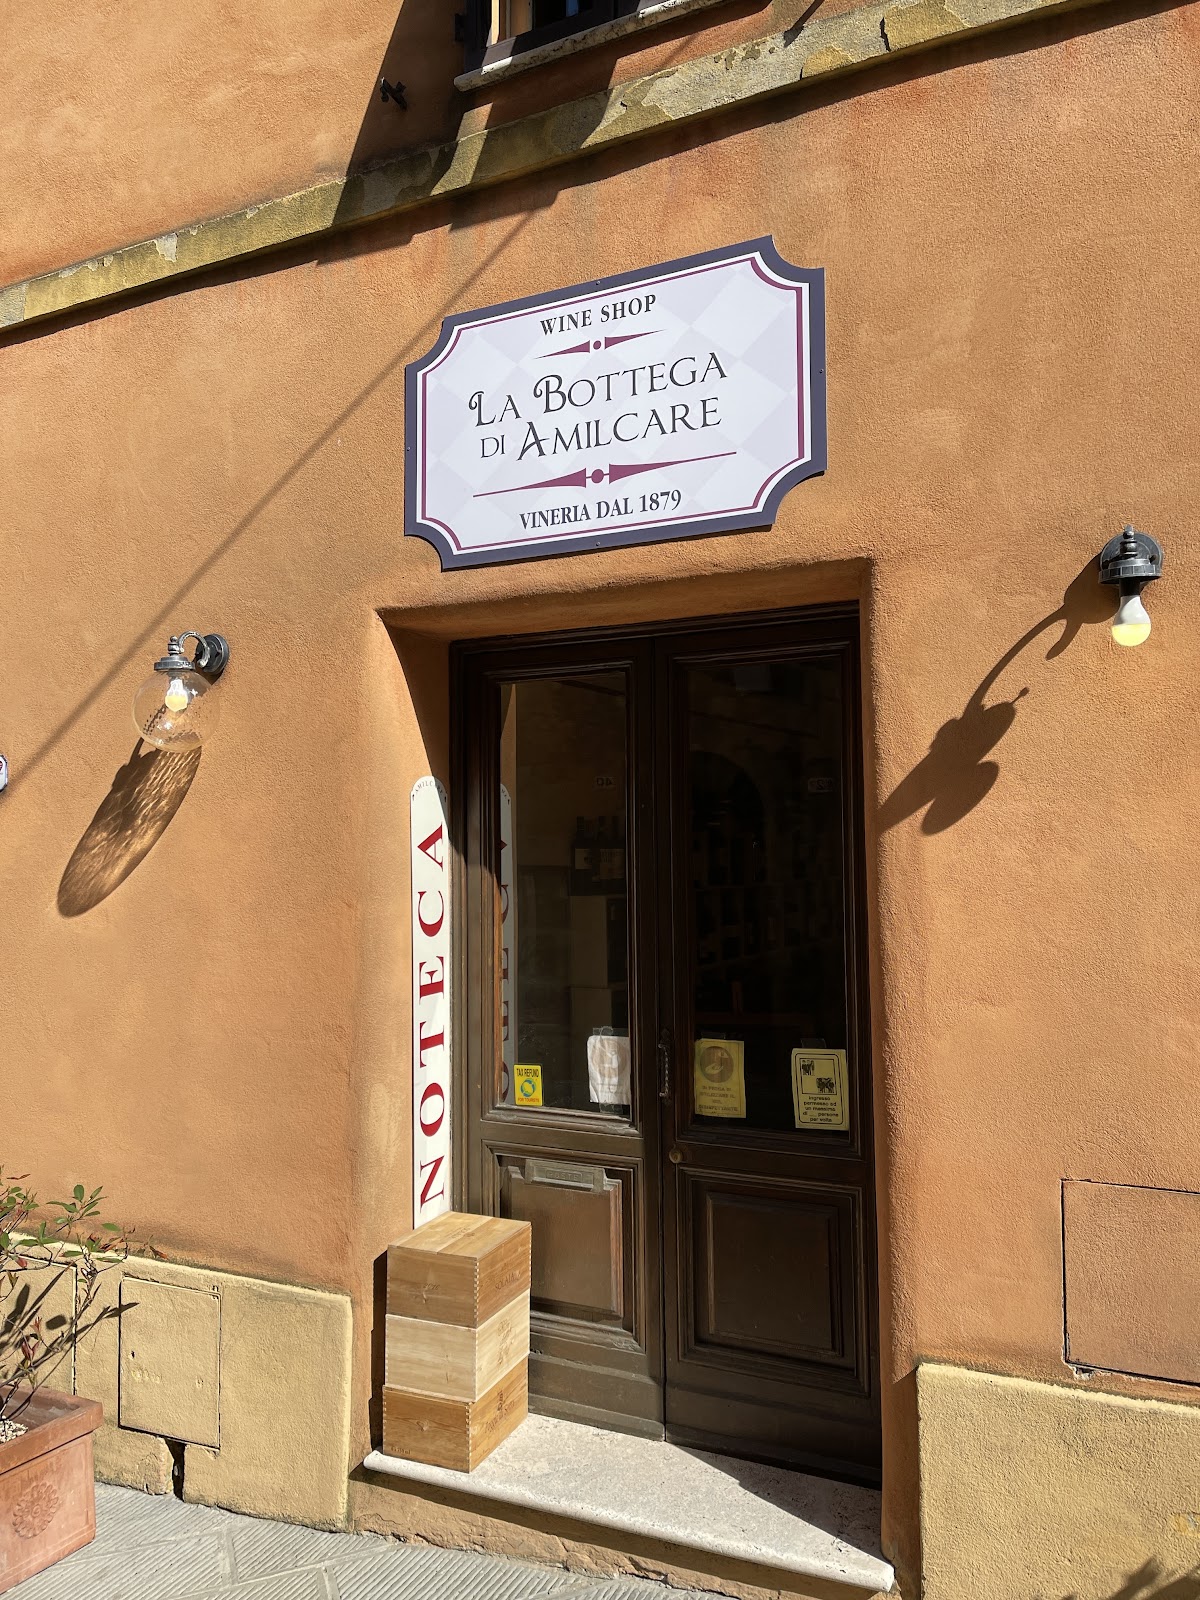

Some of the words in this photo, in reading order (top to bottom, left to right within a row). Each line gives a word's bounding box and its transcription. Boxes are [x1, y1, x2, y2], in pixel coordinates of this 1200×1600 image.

[540, 308, 593, 336] WINE
[600, 294, 657, 322] SHOP
[468, 389, 522, 427] LA
[533, 352, 728, 414] BOTTEGA
[480, 433, 506, 459] DI
[516, 397, 722, 462] AMILCARE
[519, 503, 591, 530] VINERIA
[596, 497, 634, 519] DAL
[639, 489, 682, 513] 1879
[417, 822, 446, 1214] NOTECA
